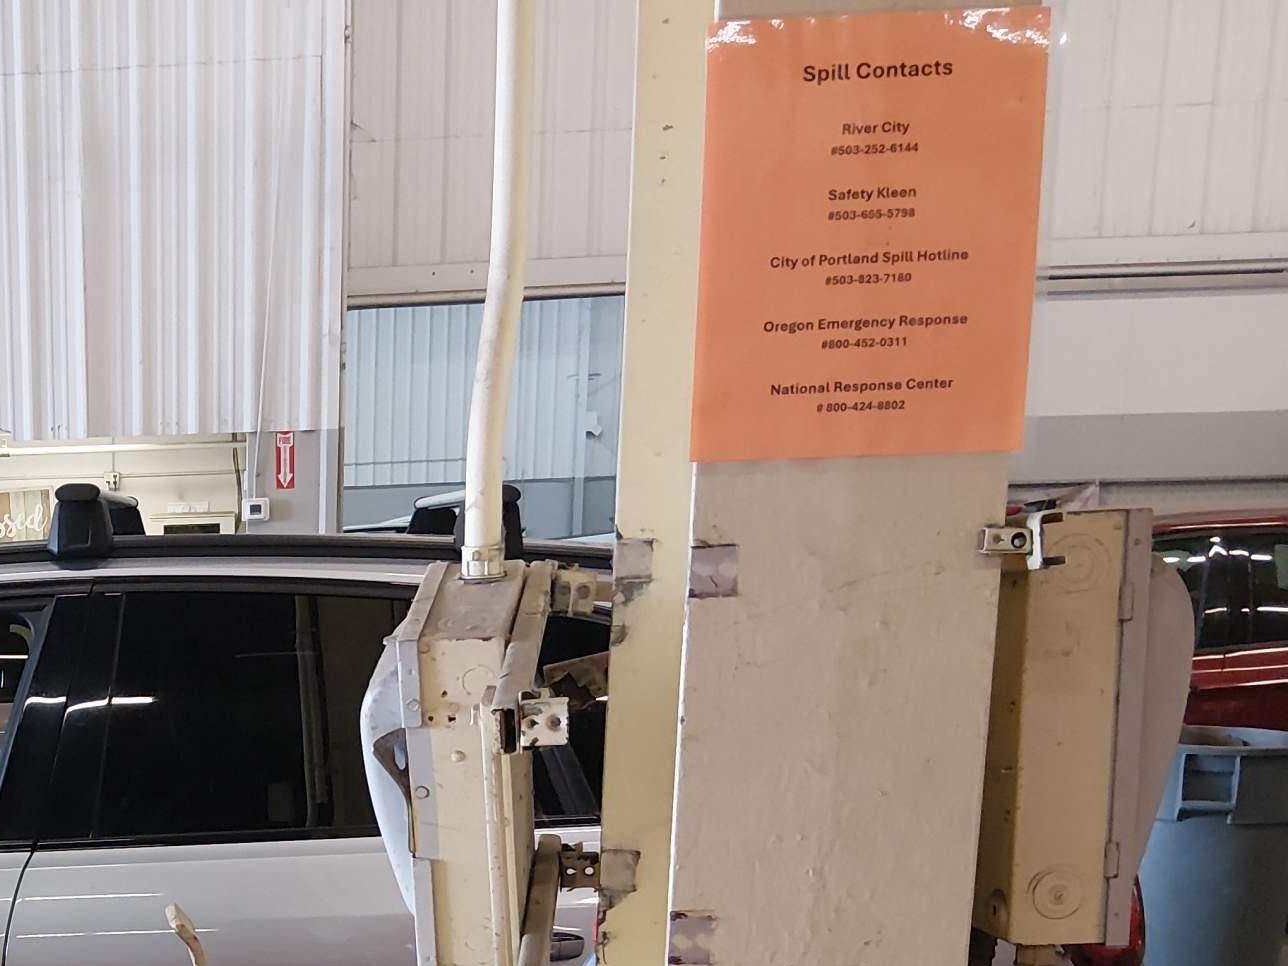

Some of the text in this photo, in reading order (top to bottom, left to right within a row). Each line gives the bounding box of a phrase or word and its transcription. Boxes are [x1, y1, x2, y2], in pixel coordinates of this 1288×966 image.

[803, 60, 953, 86] Spill Contacts
[842, 120, 910, 136] River City
[830, 142, 919, 156] #503-252-6144
[828, 186, 917, 202] Safety Kleen
[770, 248, 969, 271] City of Portland Spill Hotline
[825, 272, 912, 286] #503-823-7180
[763, 314, 968, 334] Oregon Emergency Response
[821, 336, 907, 350] #800-452-0311
[770, 377, 954, 395] National Response Center
